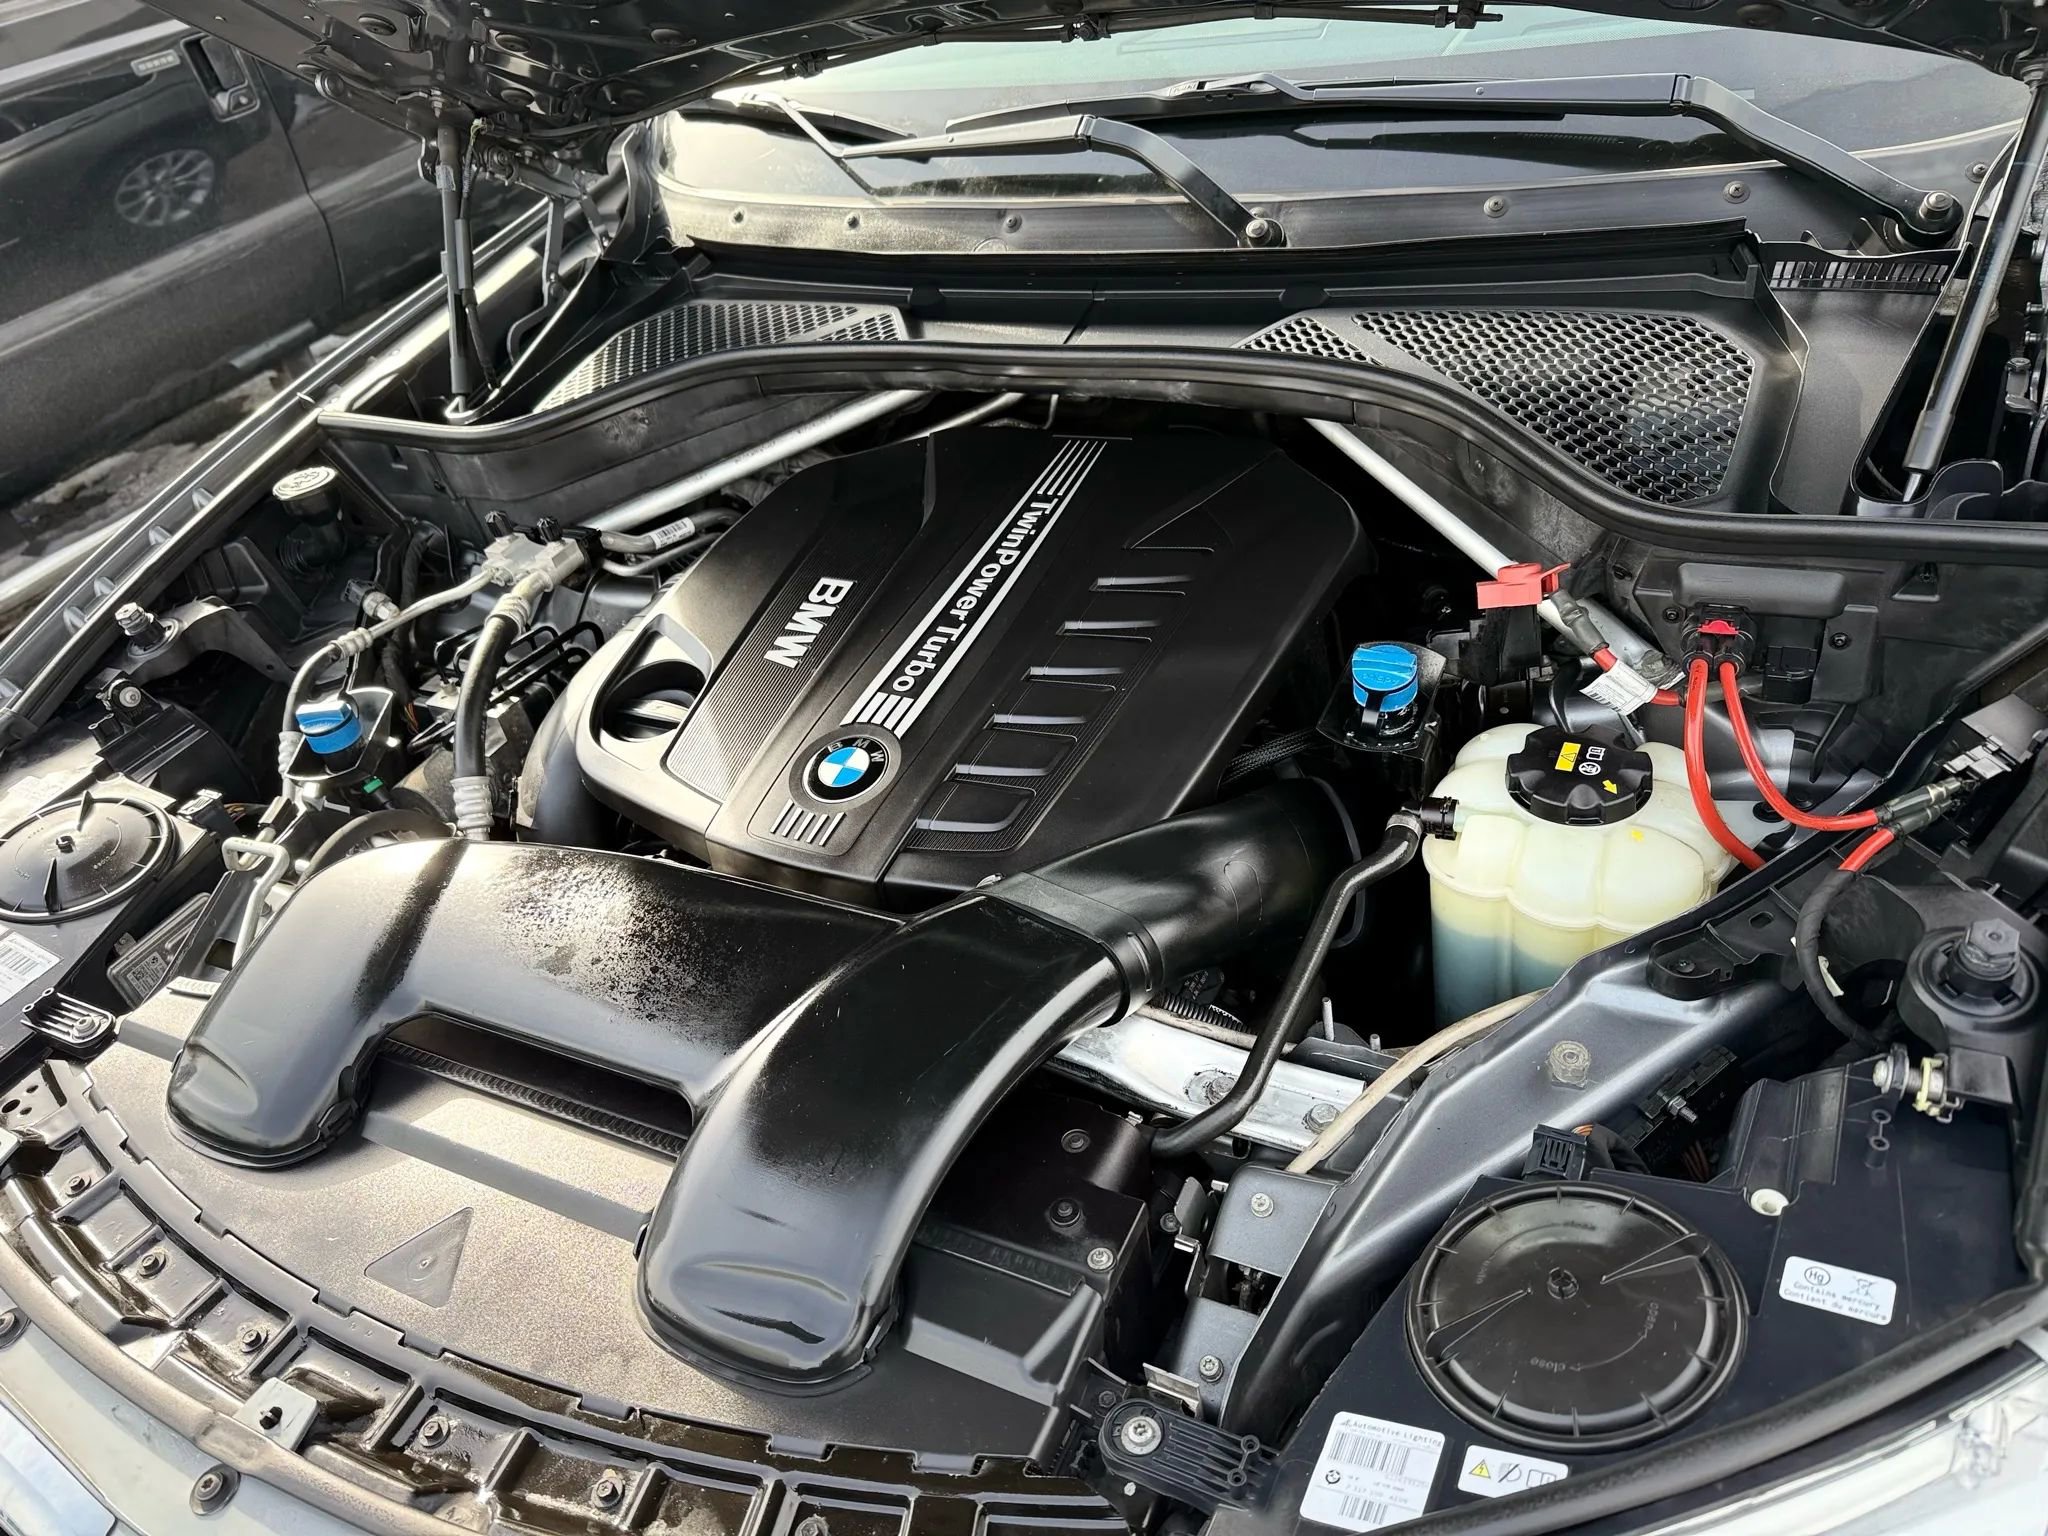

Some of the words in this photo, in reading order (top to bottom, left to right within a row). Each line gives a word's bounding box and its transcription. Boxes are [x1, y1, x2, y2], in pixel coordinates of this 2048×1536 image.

[949, 497, 1059, 621] TwinPower
[763, 576, 855, 669] BMW
[892, 622, 967, 692] Turbo
[1808, 1270, 1824, 1286] Hg
[1784, 1288, 1826, 1305] Contient
[1848, 1306, 1887, 1321] mercure
[1793, 1281, 1837, 1299] Contains
[1842, 1294, 1880, 1311] mercury
[1530, 1356, 1566, 1374] close
[1352, 1421, 1400, 1437] Automotive
[1404, 1431, 1443, 1448] Lighting
